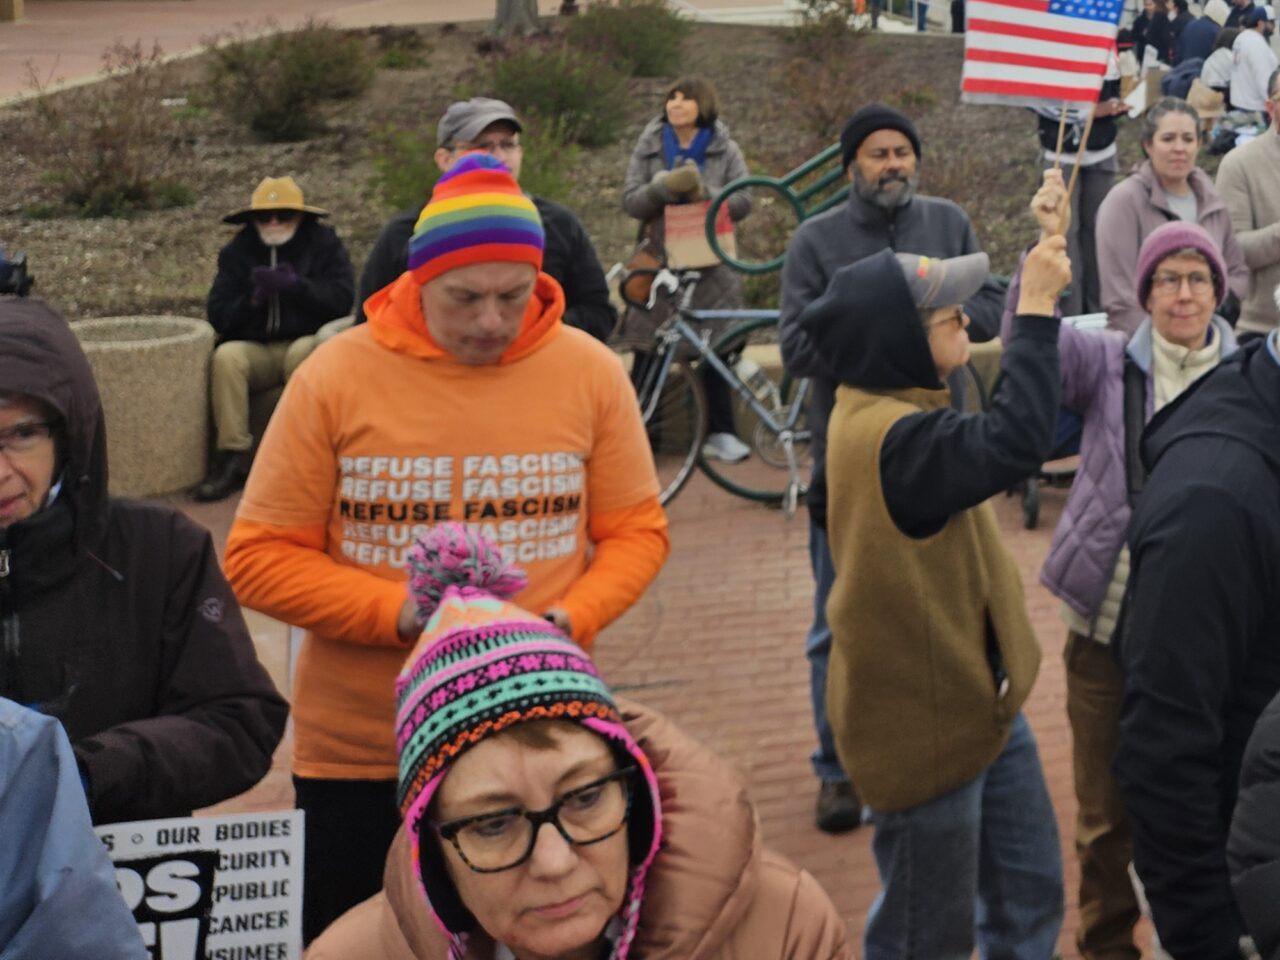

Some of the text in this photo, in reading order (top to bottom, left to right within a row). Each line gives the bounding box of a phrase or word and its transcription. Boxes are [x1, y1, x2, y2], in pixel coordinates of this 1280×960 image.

[340, 456, 453, 479] REFUSE
[341, 472, 583, 503] REFUSE FASCISM
[340, 494, 581, 522] REFUSE FASCISM
[157, 819, 291, 847] OUR BODIES
